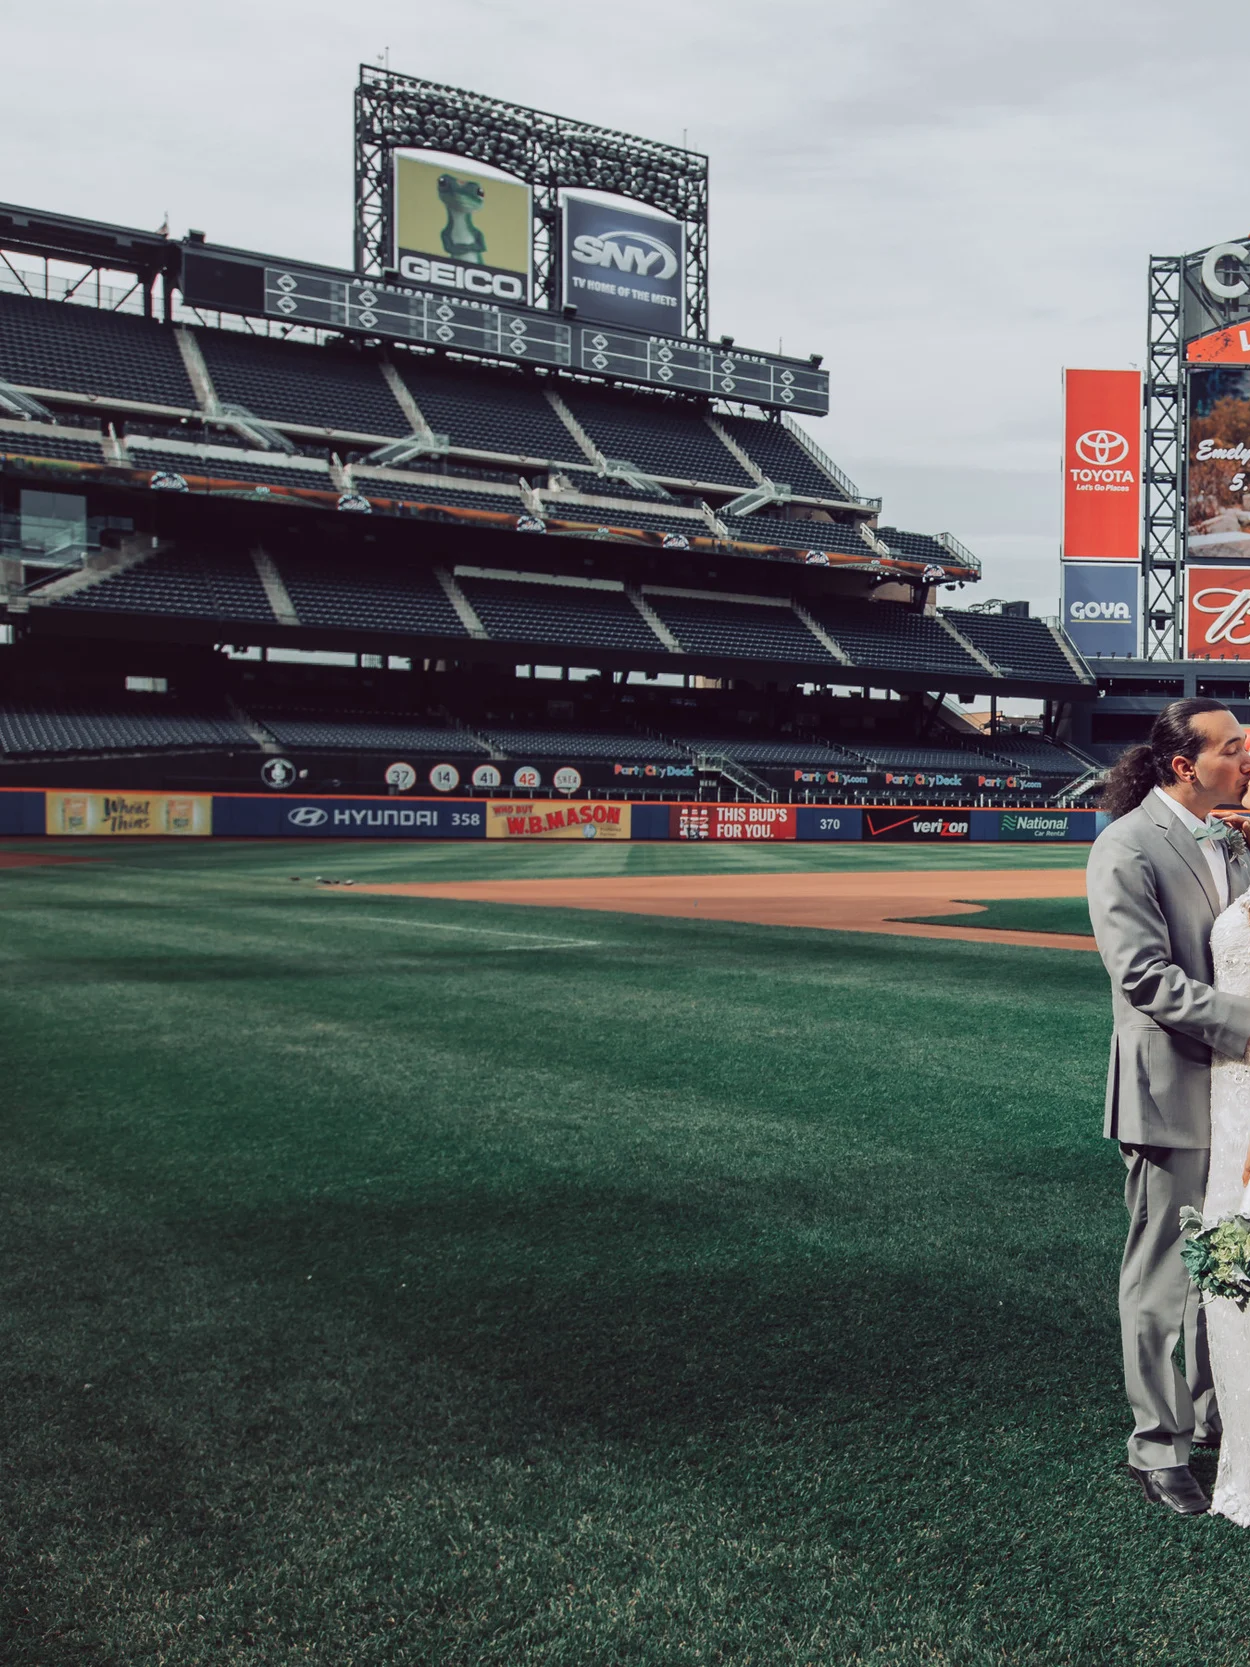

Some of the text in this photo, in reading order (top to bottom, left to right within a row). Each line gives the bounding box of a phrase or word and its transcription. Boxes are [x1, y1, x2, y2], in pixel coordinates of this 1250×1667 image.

[572, 234, 661, 276] SNY
[400, 256, 523, 300] GEICO
[352, 278, 500, 314] AMERICAN LEAGUE
[572, 276, 678, 307] TV HOME OF THE METS
[650, 336, 767, 364] NATIONAL LEAGUE
[1070, 469, 1134, 483] TOYOTA
[1070, 601, 1130, 620] GOYA
[392, 770, 410, 784] 37
[666, 764, 694, 776] Deck
[438, 771, 451, 784] 14
[480, 772, 494, 784] 41
[519, 773, 536, 785] 42
[557, 775, 577, 785] SHEA
[936, 774, 961, 786] Deck
[493, 804, 534, 814] WHO BUT
[717, 808, 787, 822] THIS BUD'S
[334, 810, 438, 826] HYUNDAI
[452, 813, 480, 826] 358
[820, 818, 840, 830] 370
[1016, 816, 1067, 830] National
[717, 824, 774, 838] FOR YOU.
[913, 818, 968, 836] verizon
